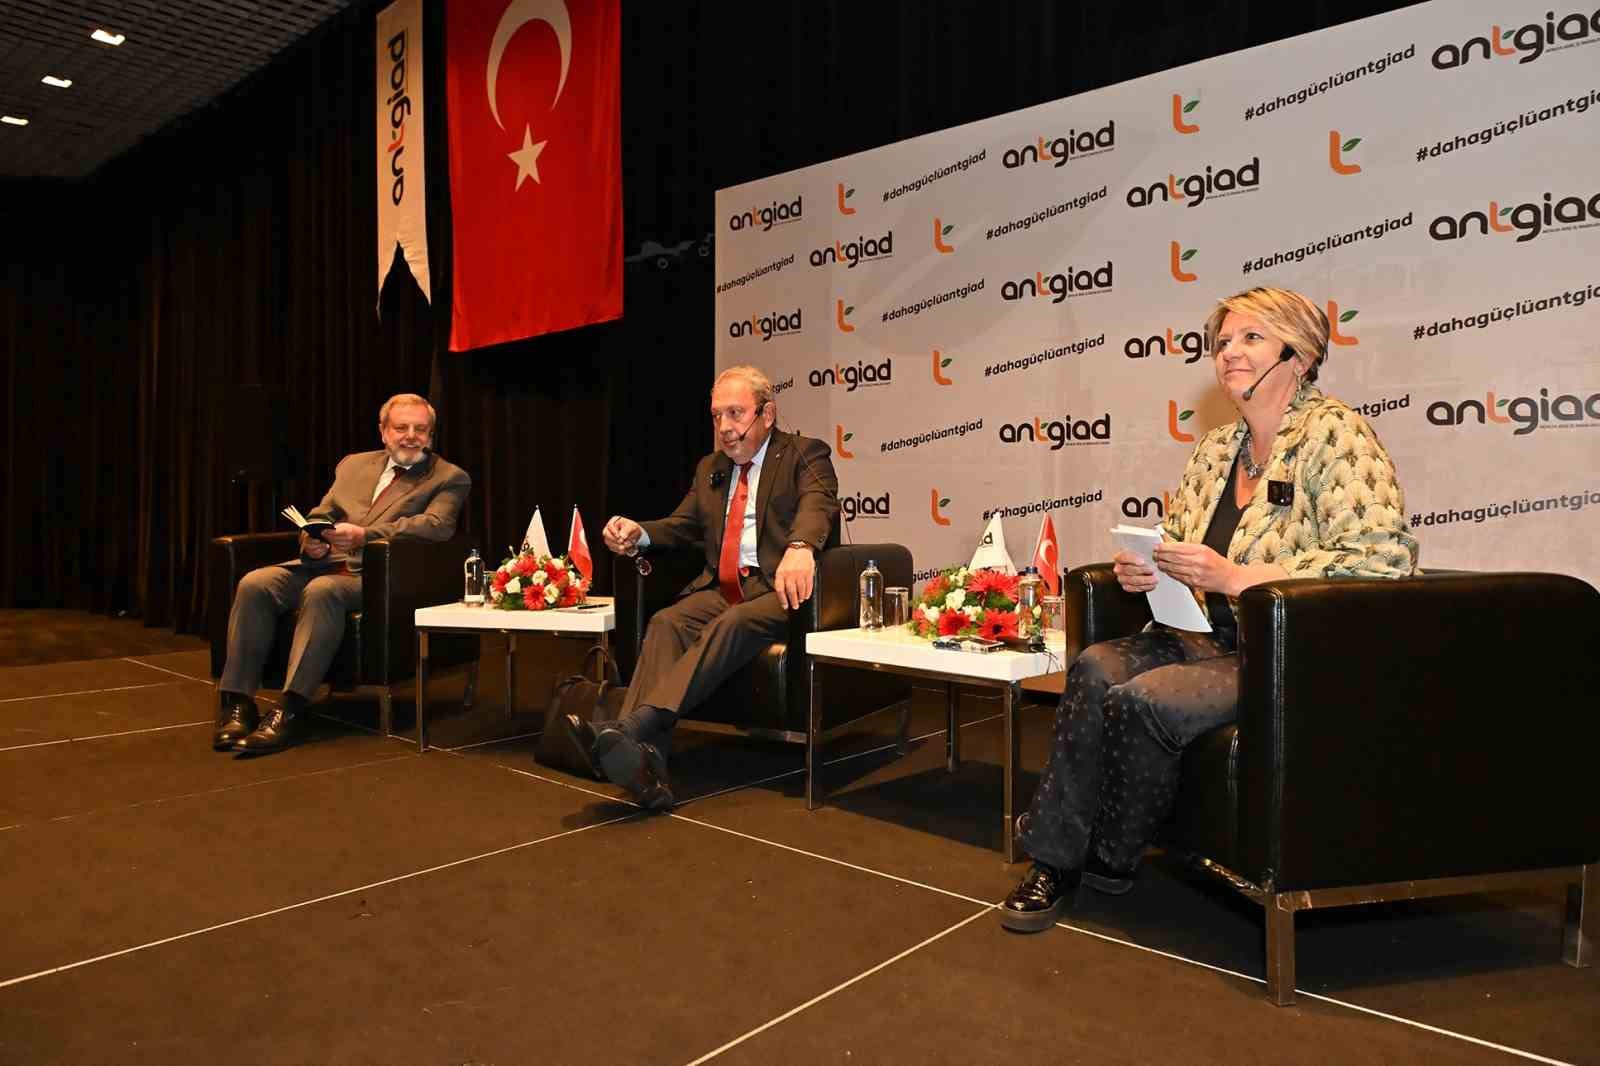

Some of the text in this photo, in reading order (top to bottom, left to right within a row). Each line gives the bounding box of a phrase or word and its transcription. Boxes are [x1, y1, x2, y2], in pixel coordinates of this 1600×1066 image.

[1244, 44, 1415, 120] #dahagüçlüantgiad
[1002, 120, 1115, 168] antgiad
[1417, 89, 1600, 162] #dahagüçlüantgi
[1126, 157, 1260, 208] antgiad
[729, 196, 802, 231] antgiad
[986, 186, 1107, 240] #dahagüçlüantgiad
[809, 231, 893, 268] antgiad
[1242, 212, 1413, 275] #dahagüçlüantgiad
[1000, 261, 1113, 304] antgiad
[729, 308, 802, 341] antgiad
[1124, 323, 1210, 364] antgi
[808, 358, 892, 392] antgiad
[984, 334, 1105, 377] #dahagüçlüantgiad
[999, 413, 1111, 451] antgiad
[1410, 490, 1600, 528] #dahagüçlüantgia
